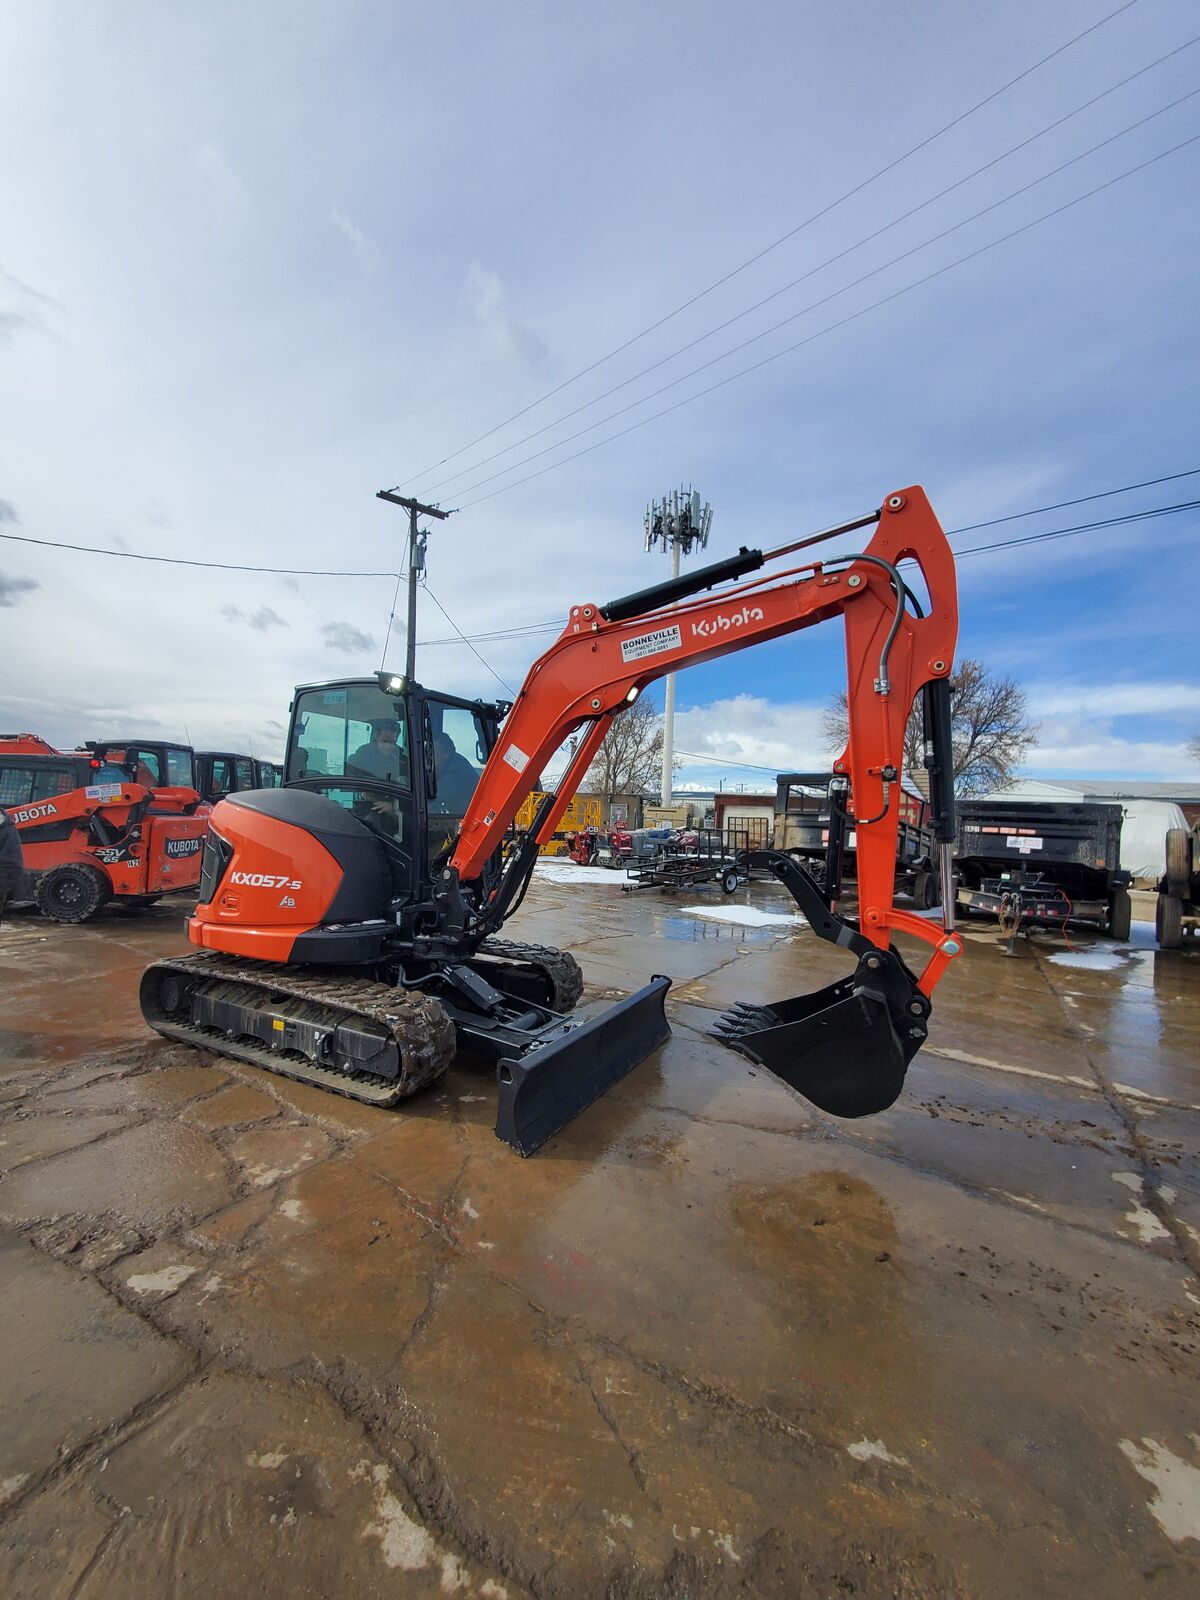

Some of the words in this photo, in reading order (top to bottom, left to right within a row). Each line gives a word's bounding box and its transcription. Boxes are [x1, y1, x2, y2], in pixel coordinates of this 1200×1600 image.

[691, 607, 764, 637] Kubota
[623, 628, 679, 650] BONNEVILLE
[624, 643, 653, 655] EQUIPMENT
[653, 635, 679, 647] COMPANY
[13, 803, 58, 824] BOTA
[95, 848, 125, 857] SSV
[167, 840, 199, 853] KUBOTA
